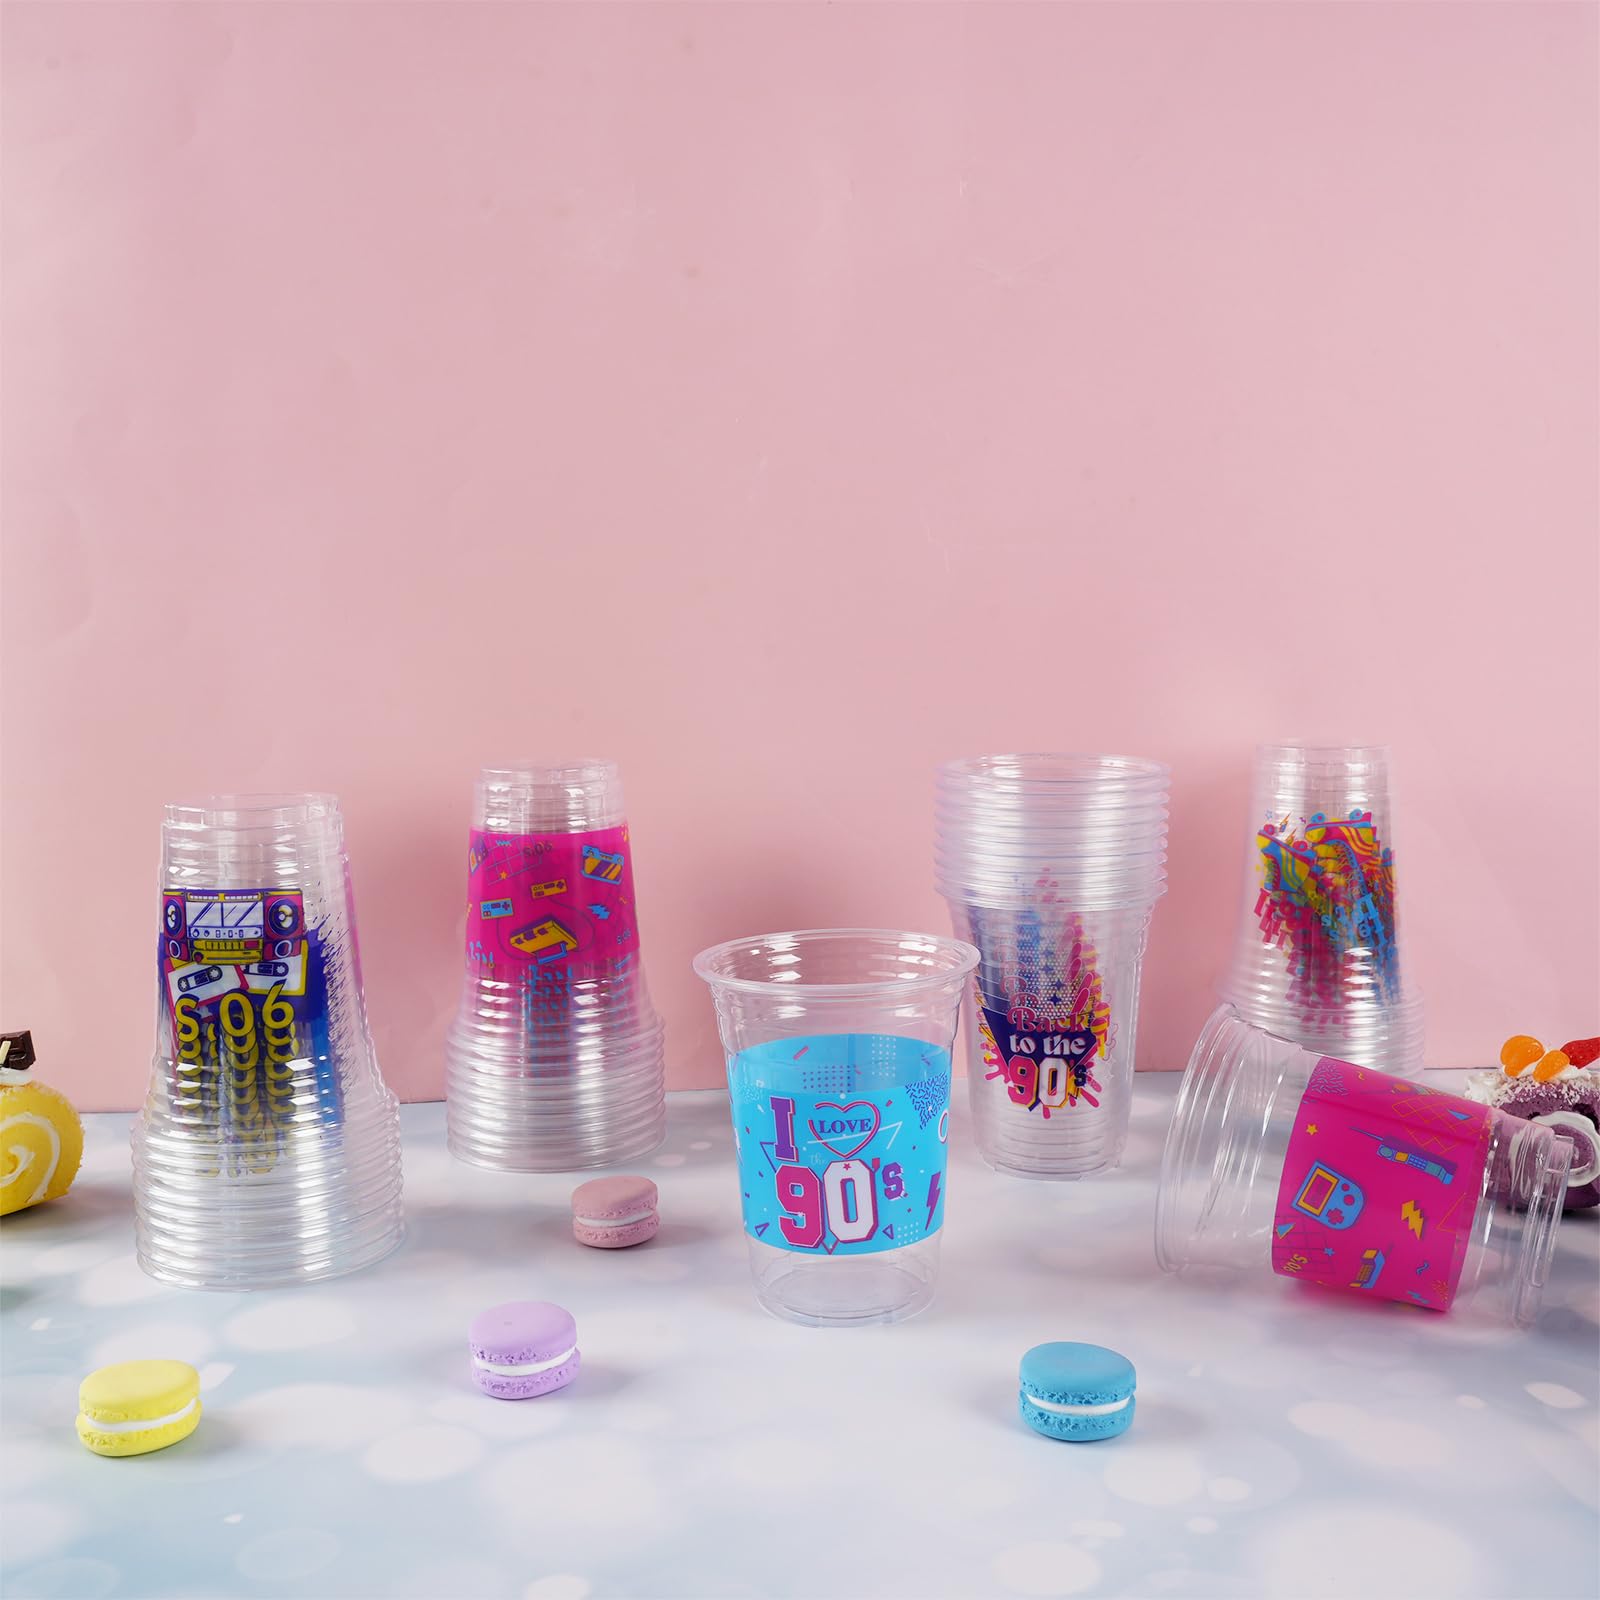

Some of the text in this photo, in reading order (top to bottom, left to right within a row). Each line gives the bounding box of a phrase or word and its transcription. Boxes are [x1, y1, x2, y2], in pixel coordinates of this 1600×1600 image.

[1007, 1006, 1087, 1033] Back
[1009, 1034, 1086, 1055] to the
[770, 1096, 872, 1162] I LOVE
